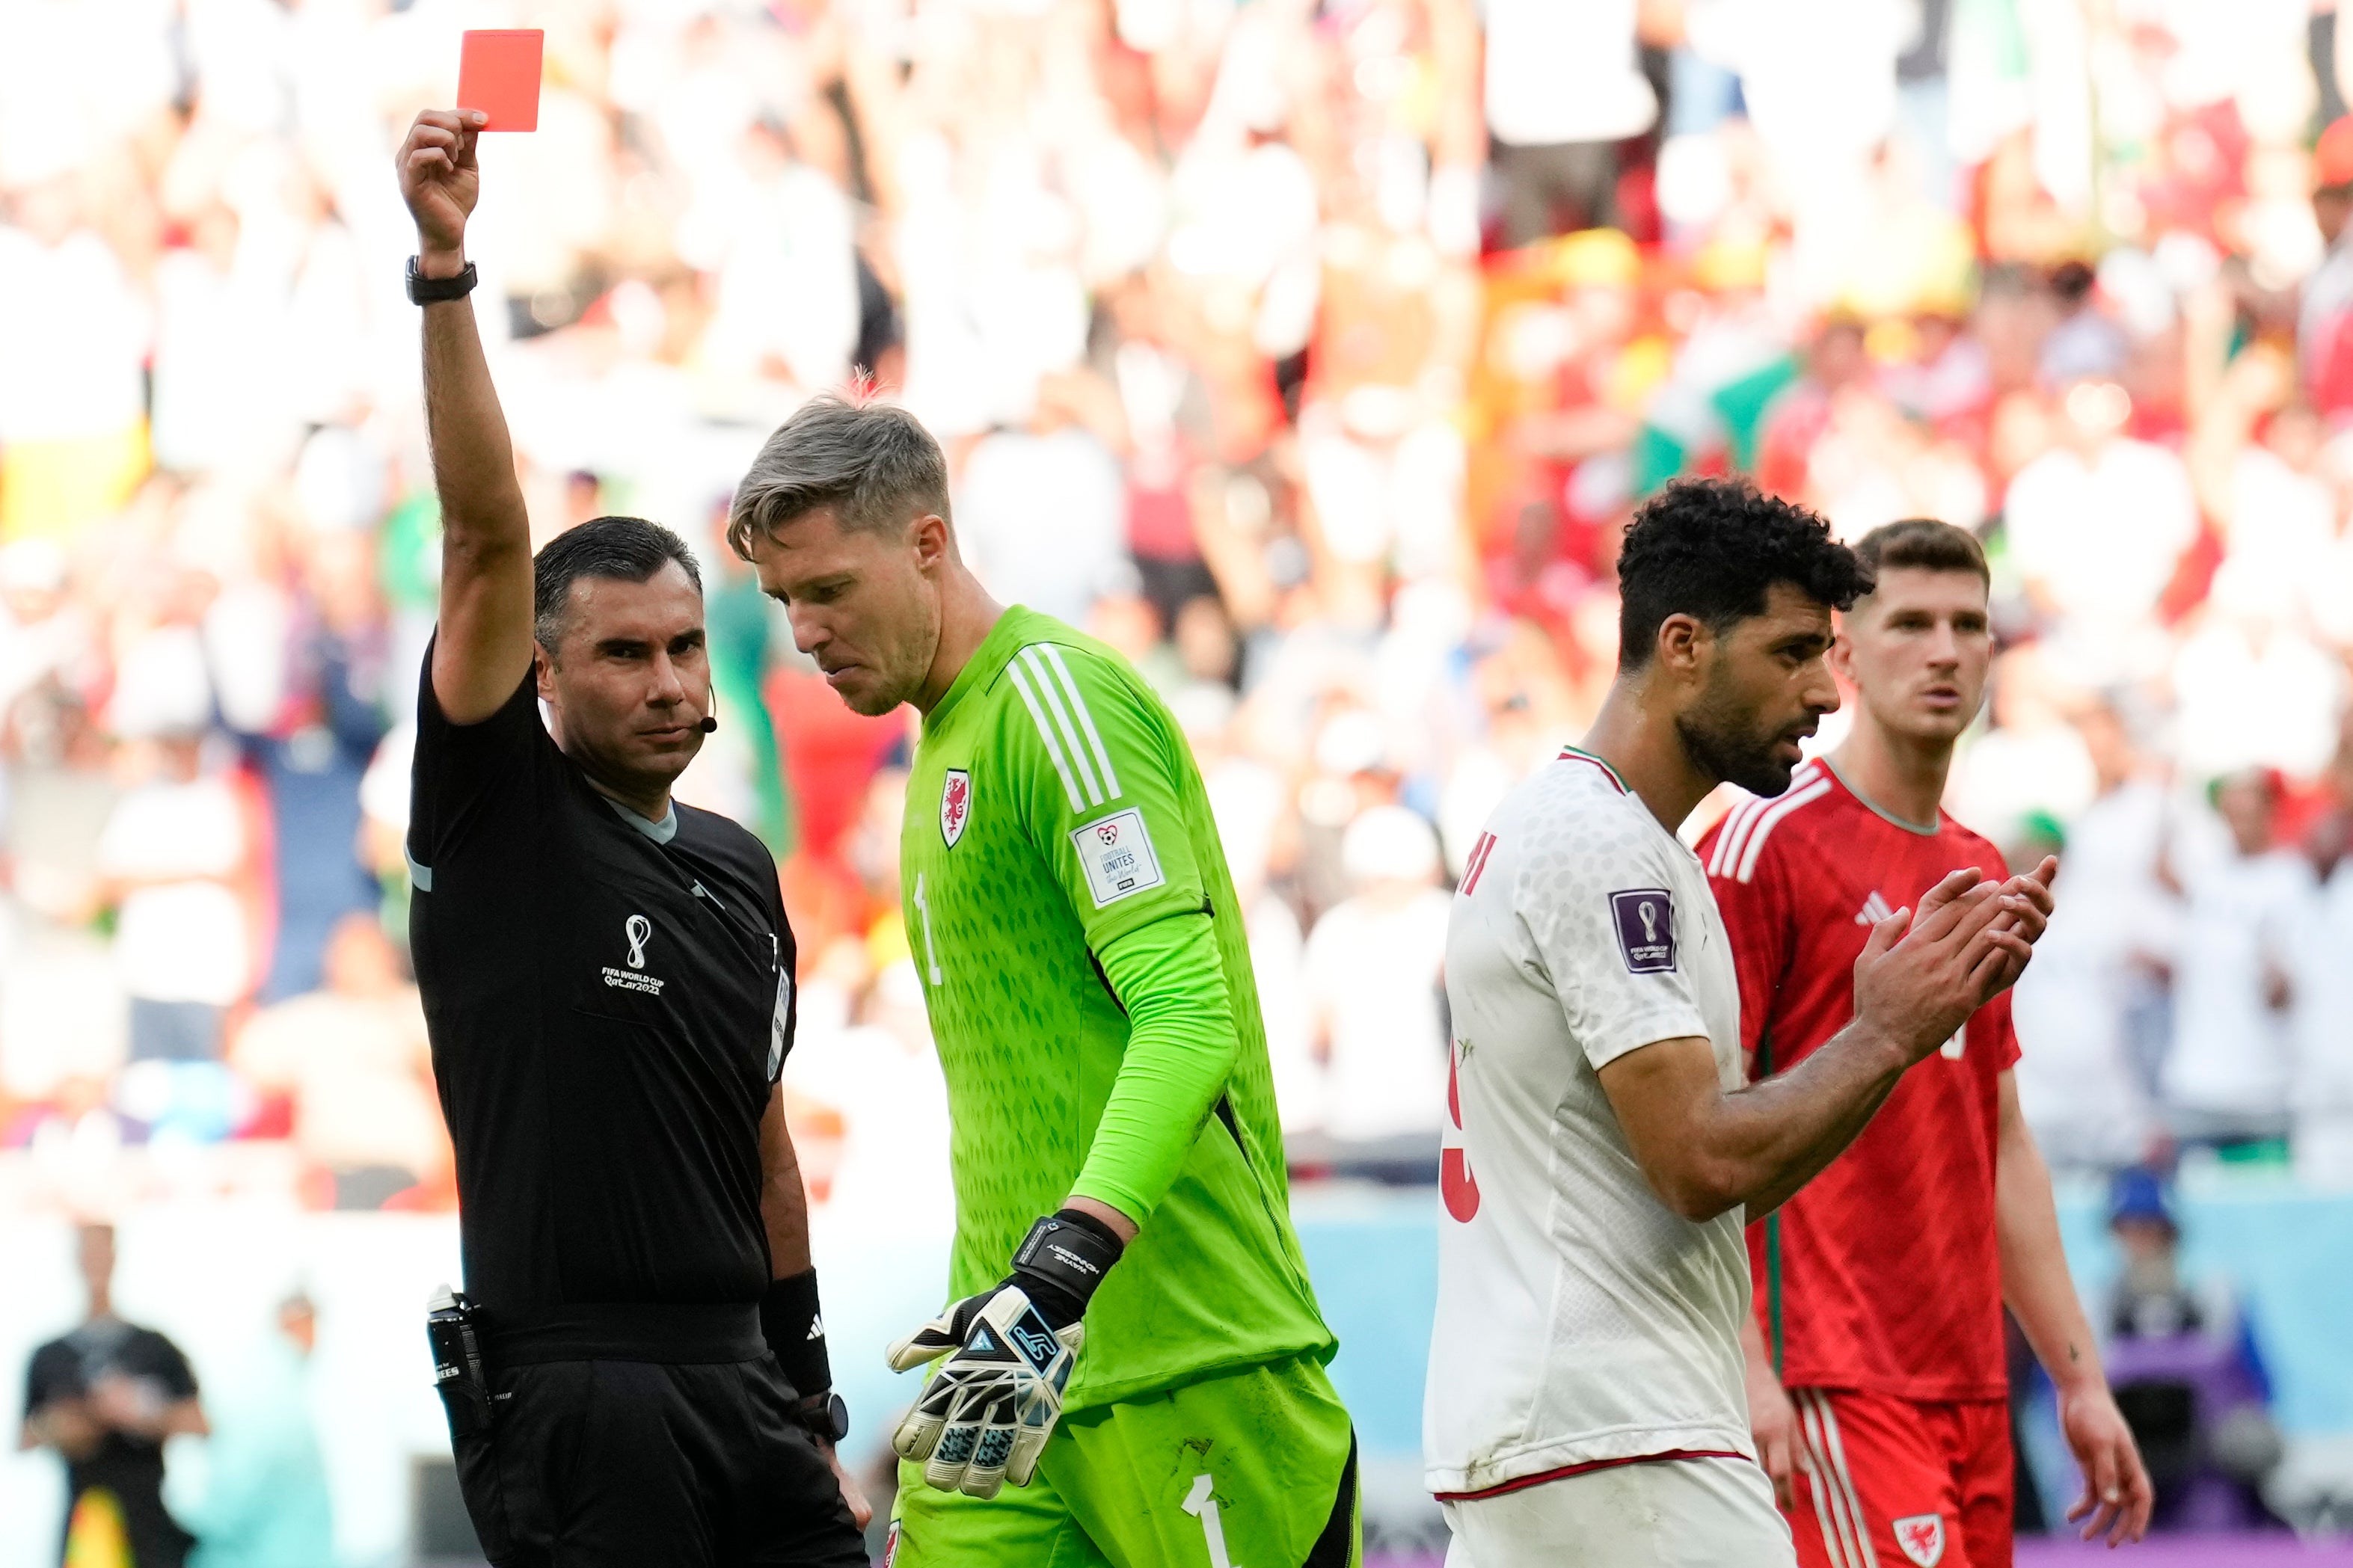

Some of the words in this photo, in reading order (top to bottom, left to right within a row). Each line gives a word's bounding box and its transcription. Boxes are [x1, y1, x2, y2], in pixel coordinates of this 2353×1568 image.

[1099, 846, 1132, 863] FOOTBALL
[1102, 853, 1135, 873] UNITES
[913, 873, 942, 986] 1
[601, 967, 620, 977] FIFA
[620, 970, 649, 983] WORLD
[649, 977, 664, 988] CUP
[1054, 1253, 1087, 1275] WAYNE
[1180, 1474, 1242, 1568] 1
